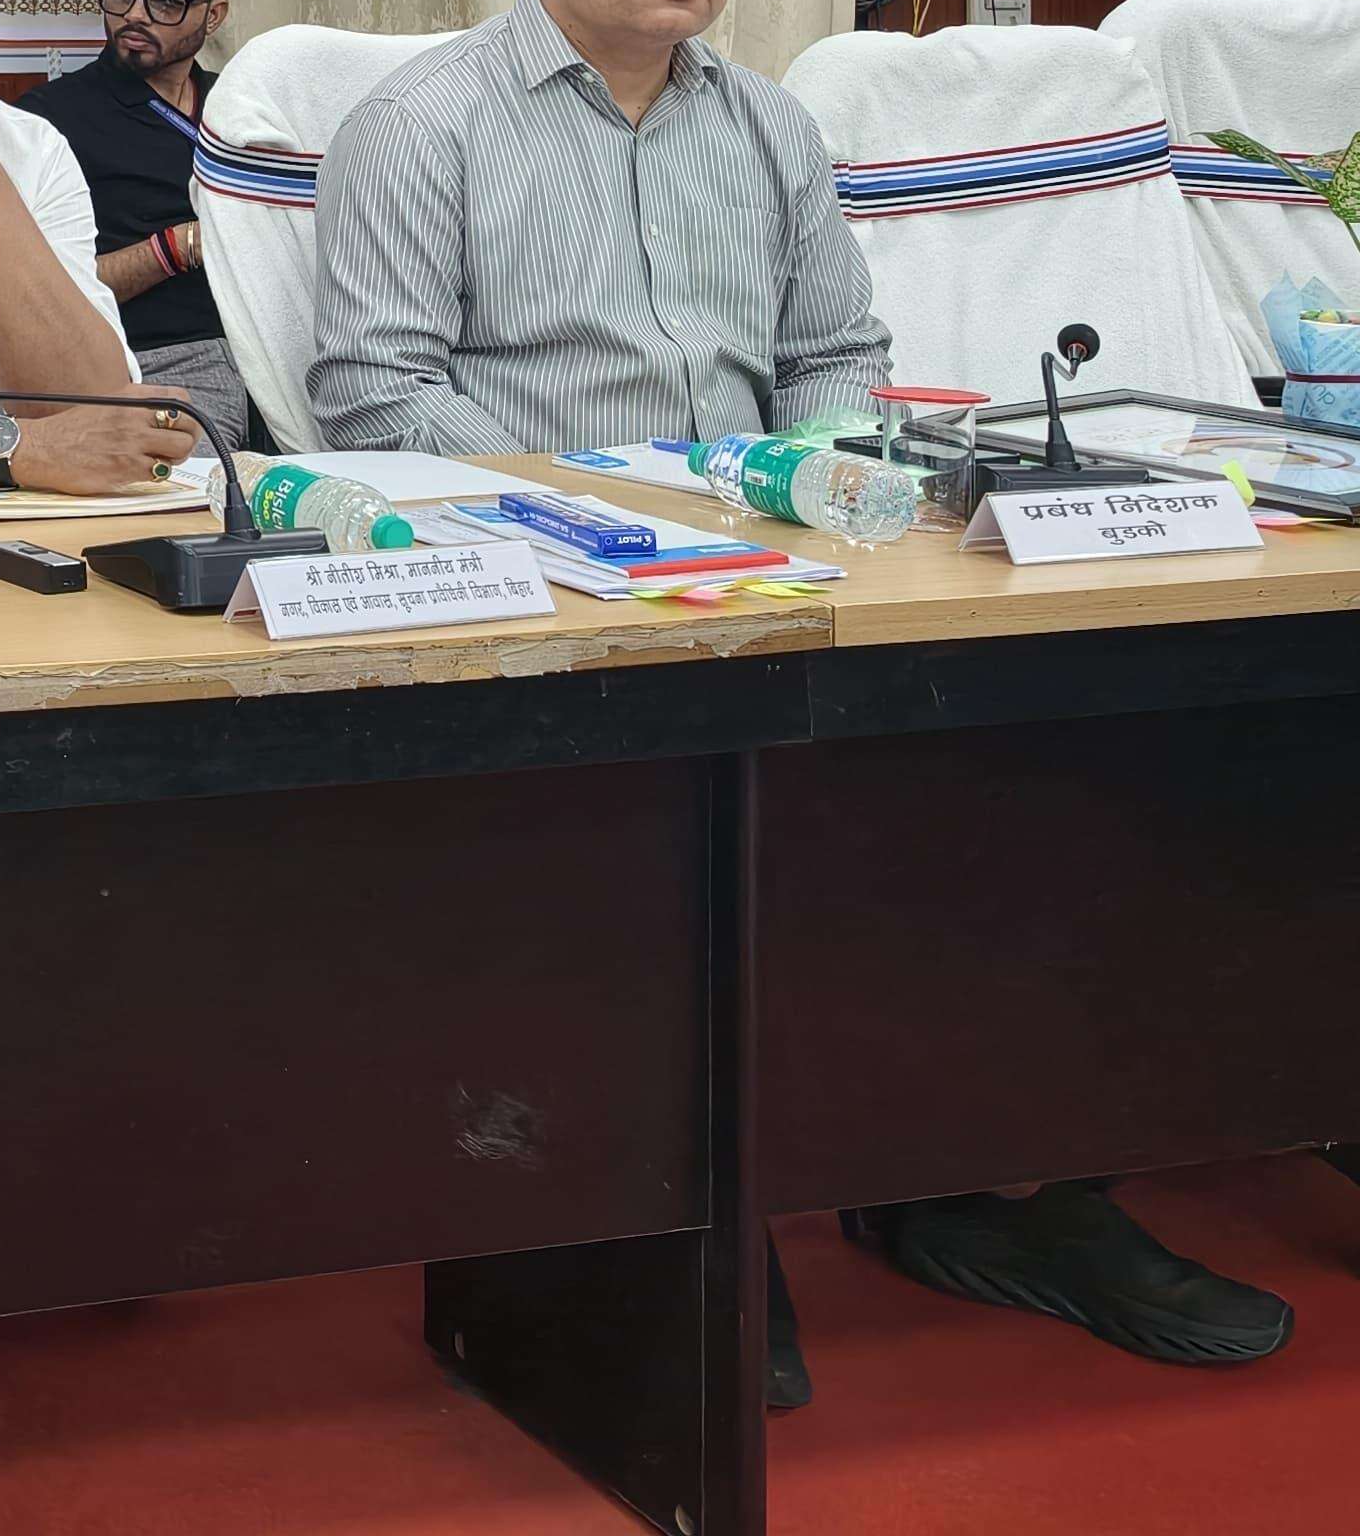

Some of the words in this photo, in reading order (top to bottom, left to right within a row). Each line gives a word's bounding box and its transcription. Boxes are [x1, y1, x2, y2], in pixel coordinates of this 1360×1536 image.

[1019, 497, 1096, 521] प्रबंध
[1104, 494, 1218, 514] निदेशक
[617, 535, 642, 545] PILOT
[1098, 520, 1167, 545] बुडको
[306, 565, 322, 585] श्री
[324, 562, 365, 584] नीतीश
[366, 560, 405, 581] मिश्रा,
[405, 554, 455, 578] माननीय
[456, 551, 484, 573] मंत्री
[306, 594, 342, 615] विकास
[360, 594, 398, 611] आवास,
[503, 577, 534, 598] बिहार
